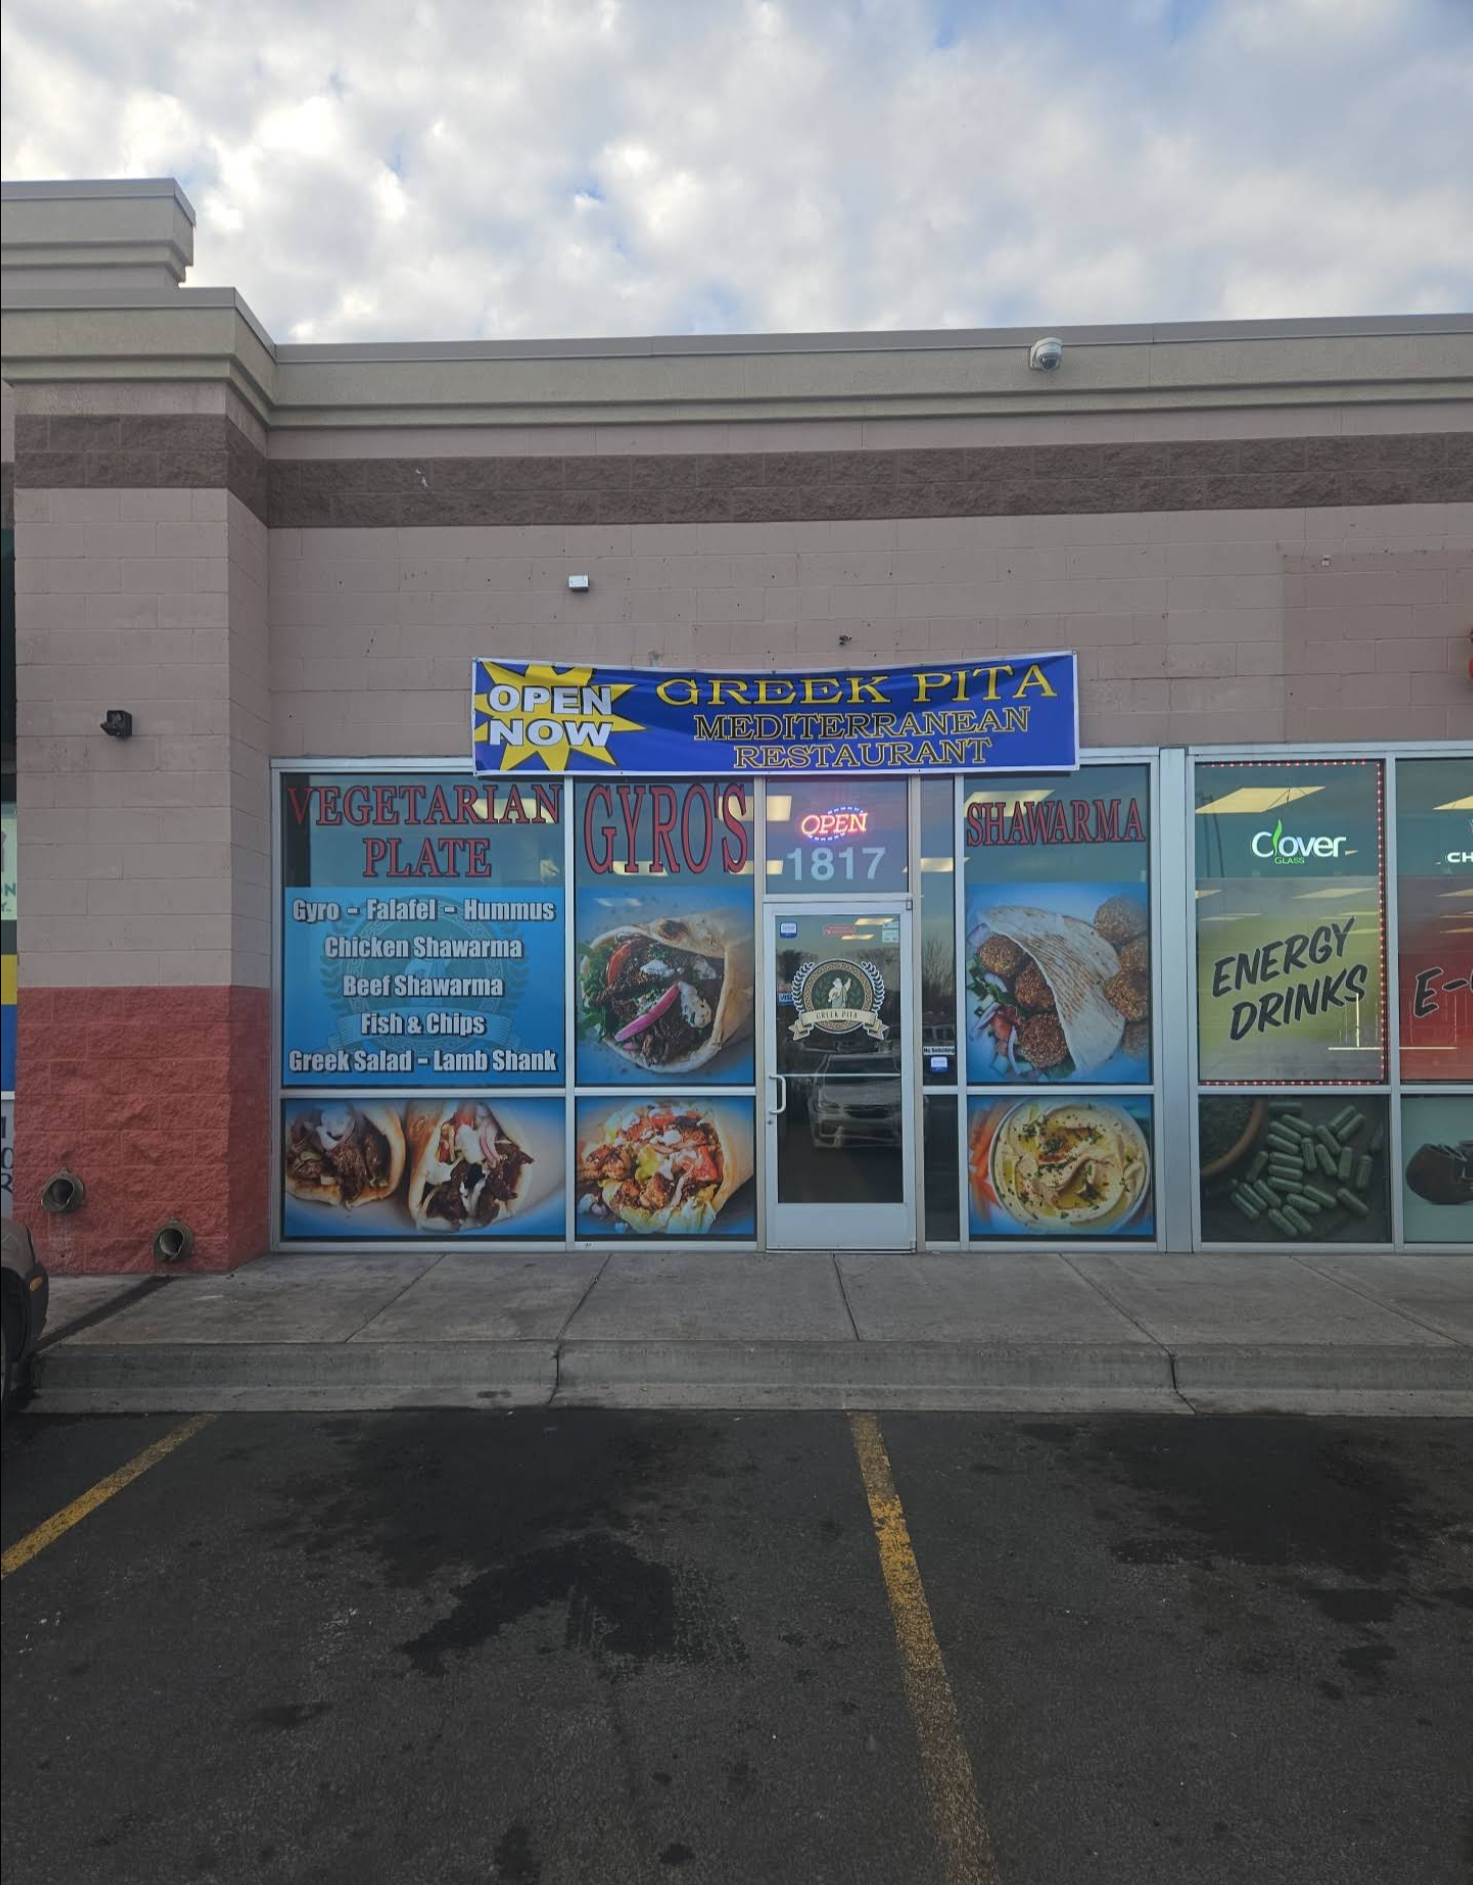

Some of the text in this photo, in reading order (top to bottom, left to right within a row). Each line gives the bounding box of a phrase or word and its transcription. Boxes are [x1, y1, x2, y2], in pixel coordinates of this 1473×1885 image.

[488, 683, 612, 715] OPEN
[655, 664, 1057, 706] GREEK PITA
[488, 718, 613, 747] NOW
[693, 706, 1031, 741] MEDITERRANEAN
[733, 738, 993, 769] RESTAURANT
[288, 784, 562, 826] VEGETARIAN
[584, 782, 749, 875] GYRO'S
[800, 812, 868, 836] OPEN
[966, 798, 1147, 847] SHAWARMA
[1251, 819, 1347, 858] Clover
[362, 837, 493, 878] PLATE
[786, 847, 886, 881] 1817
[1274, 857, 1305, 865] GLASS
[292, 898, 340, 923] Gyro
[366, 898, 436, 920] Falafel
[464, 898, 556, 920] Hummus
[324, 936, 523, 959] Chicken Shawarma
[1212, 915, 1356, 998] ENERGY
[343, 974, 504, 997] Beef Shawarma
[1230, 964, 1368, 1041] DRINKS
[361, 1012, 486, 1036] Fish & Chips
[289, 1050, 350, 1072] Greek
[354, 1050, 412, 1072] Salad
[433, 1050, 488, 1072] Lamb
[492, 1049, 557, 1072] Shank
